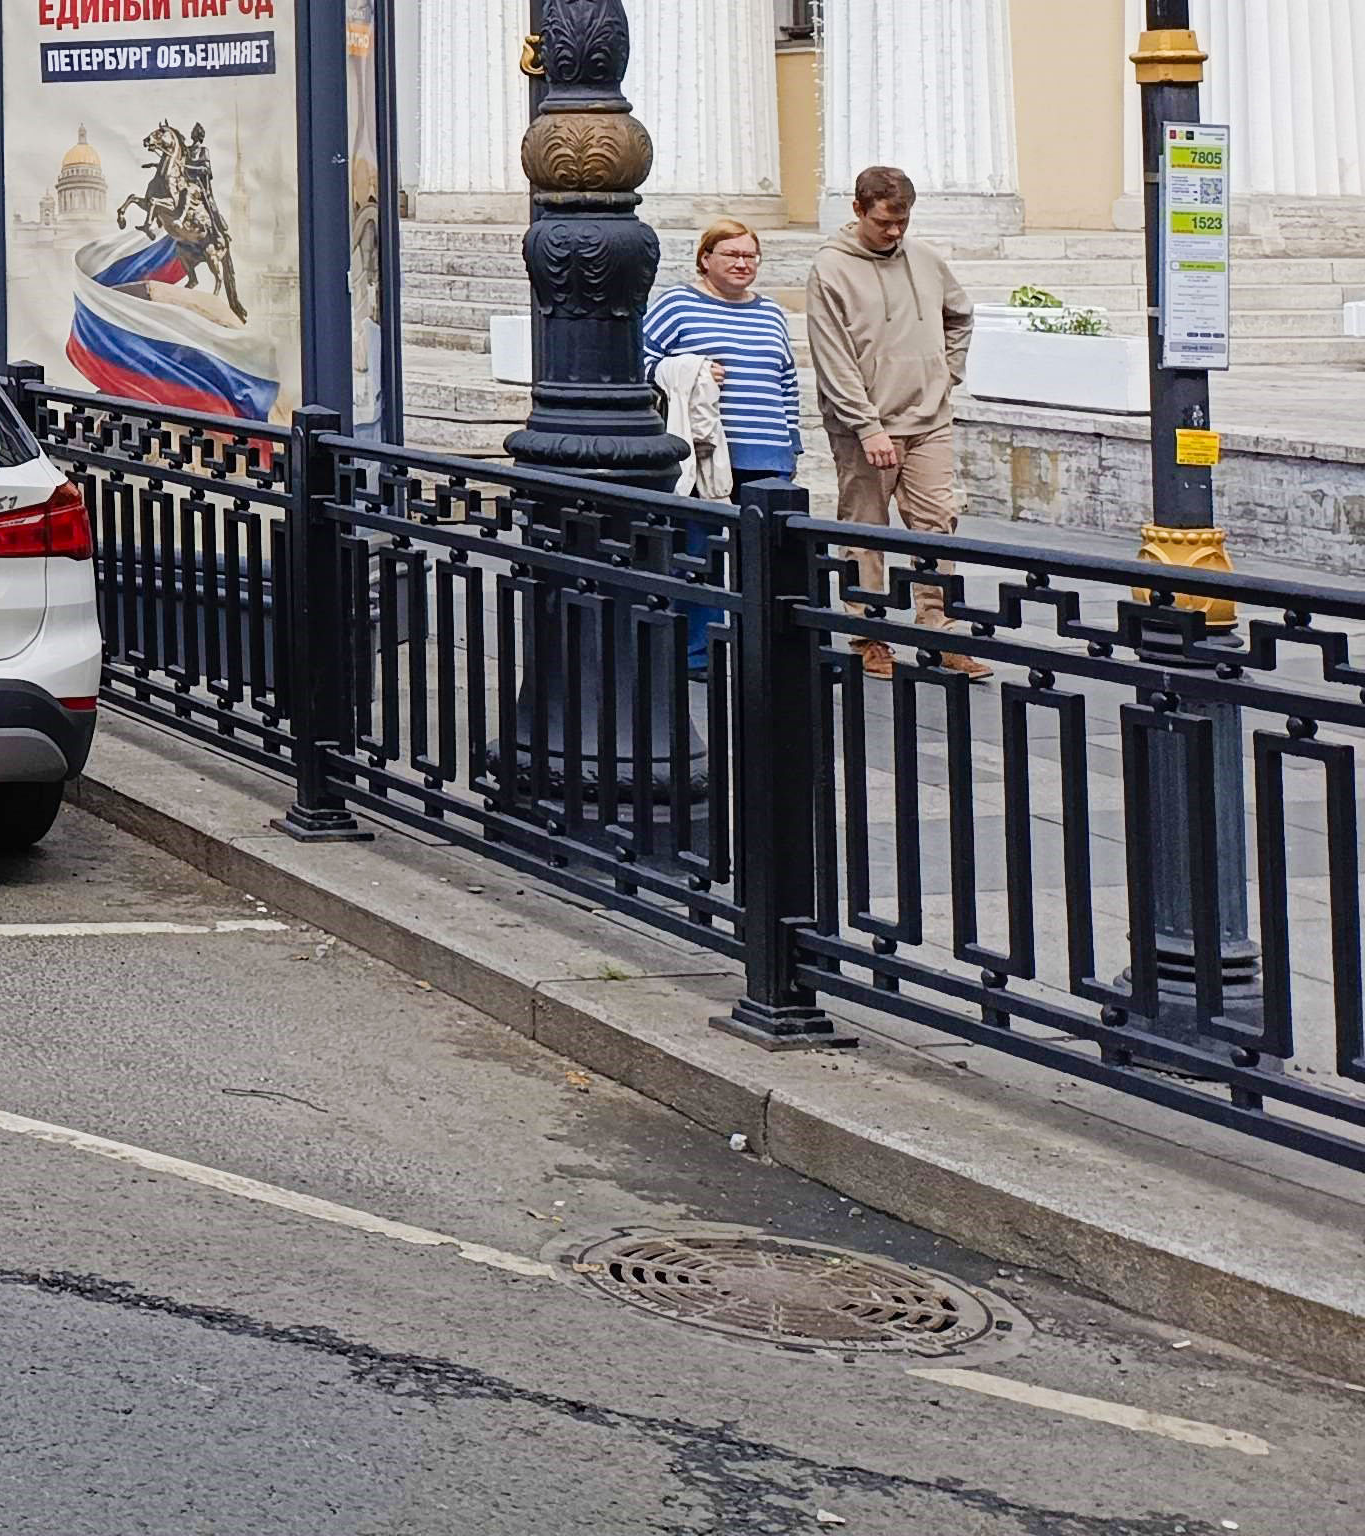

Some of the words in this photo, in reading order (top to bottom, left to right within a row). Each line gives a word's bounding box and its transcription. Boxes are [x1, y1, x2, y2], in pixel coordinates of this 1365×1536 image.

[47, 46, 152, 72] ПЕТЕРБУРГ
[156, 39, 270, 70] ОБЪЕДИНЯЕТ
[1190, 151, 1222, 164] 7805
[1192, 216, 1223, 230] 1523
